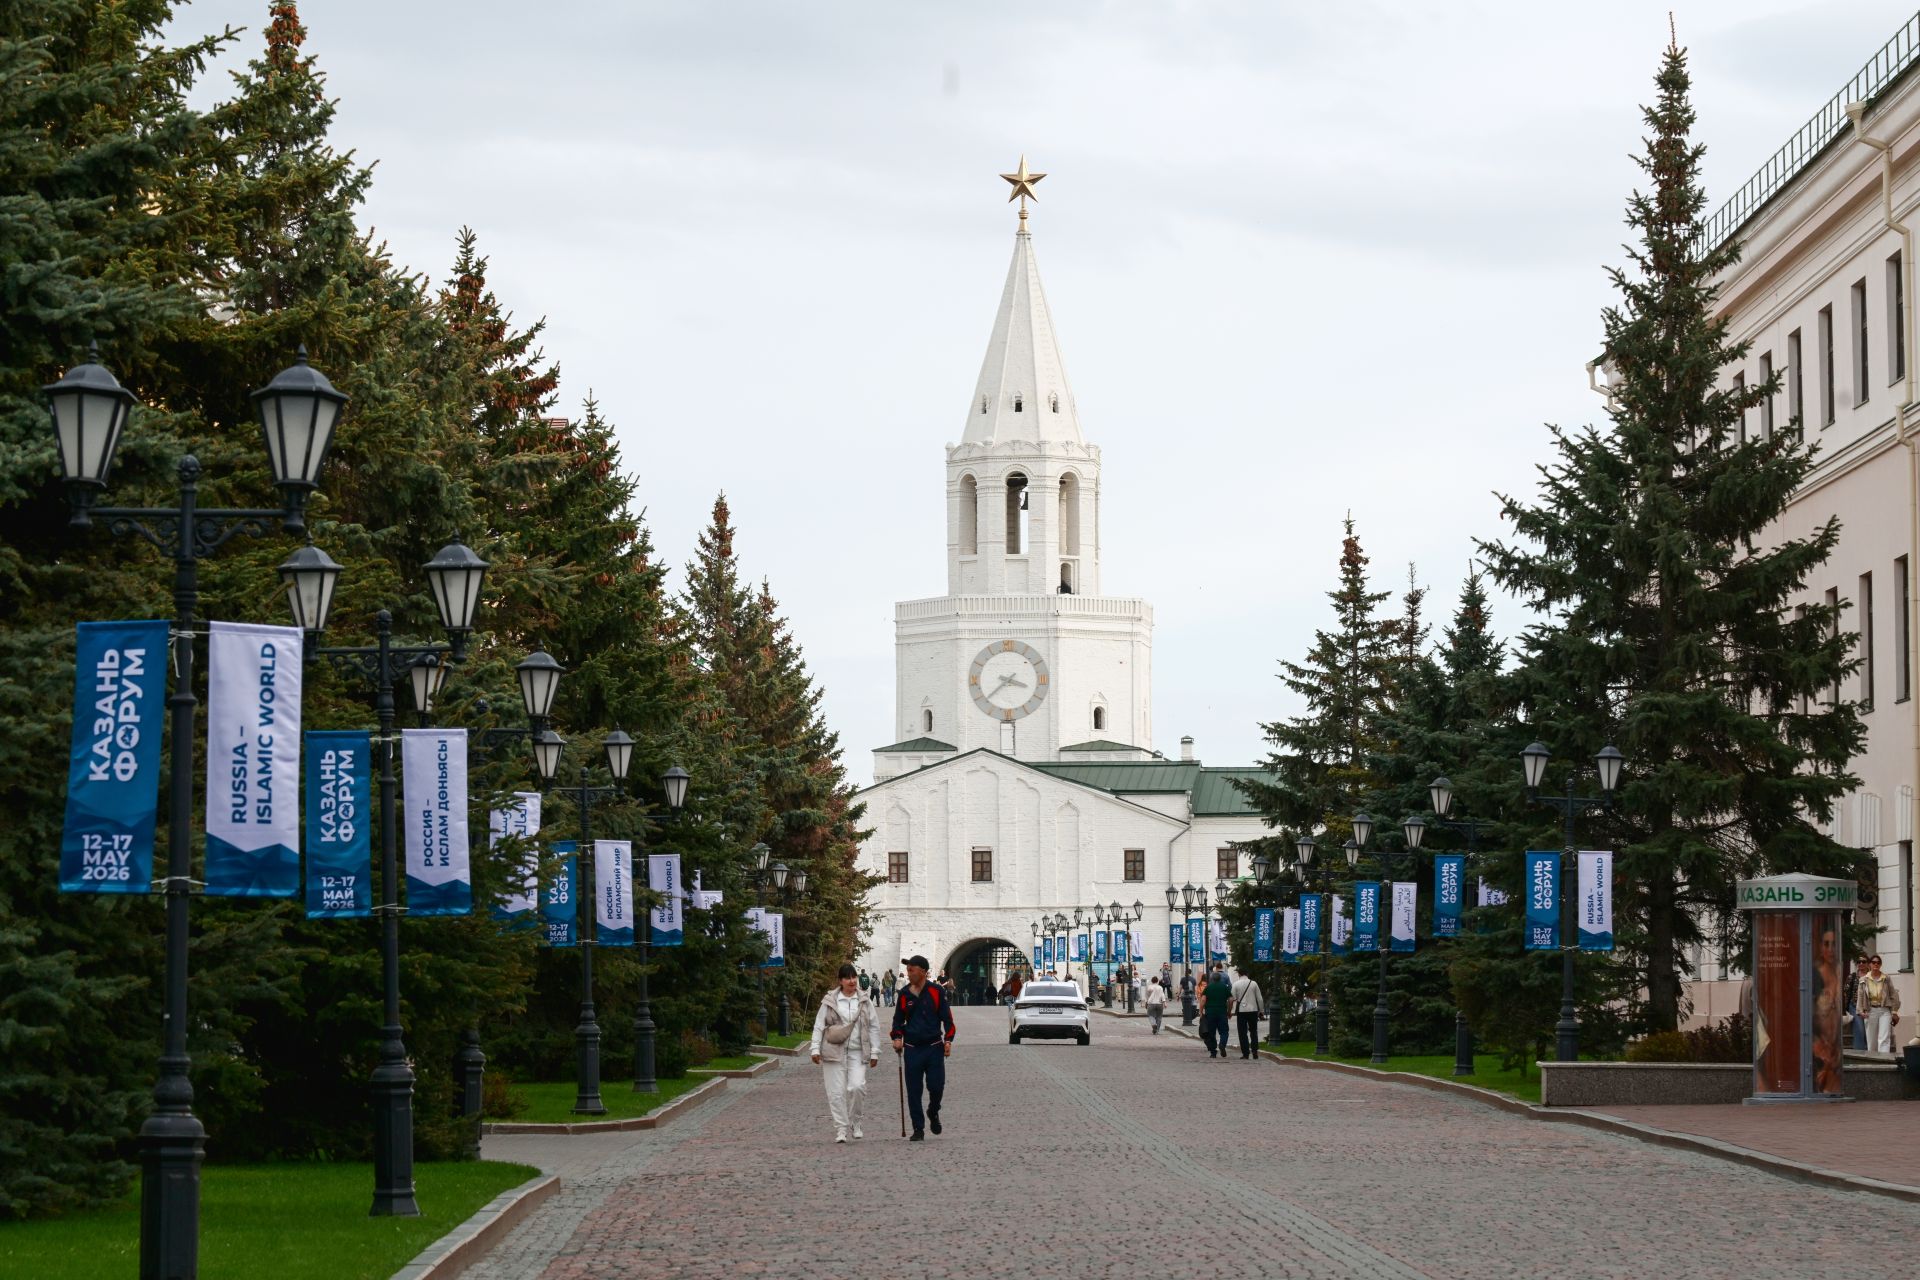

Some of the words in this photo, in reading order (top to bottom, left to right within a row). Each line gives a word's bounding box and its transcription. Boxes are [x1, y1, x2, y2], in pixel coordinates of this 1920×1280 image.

[259, 643, 276, 727] WORLD
[88, 649, 120, 781] КАЗАНЬ
[113, 649, 146, 782] ФОРУМ
[232, 743, 248, 824] RUSSIA
[257, 735, 273, 824] ISLAMIC
[321, 750, 336, 842] КАЗАНЬ
[338, 750, 354, 842] ФОРУМ
[438, 740, 450, 812] ДӨНЬЯСЫ
[82, 835, 133, 850] 12–17
[82, 851, 130, 866] MAY
[424, 810, 434, 867] РОССИЯ
[440, 814, 450, 866] ИСЛАМ
[82, 866, 130, 881] 2026
[321, 876, 355, 887] 12–17
[323, 888, 354, 900] МАЙ
[1534, 861, 1542, 909] КАЗАНЬ
[1544, 861, 1552, 909] ФОРУМ
[1741, 886, 1804, 902] КАЗАНЬ
[323, 900, 354, 910] 2026
